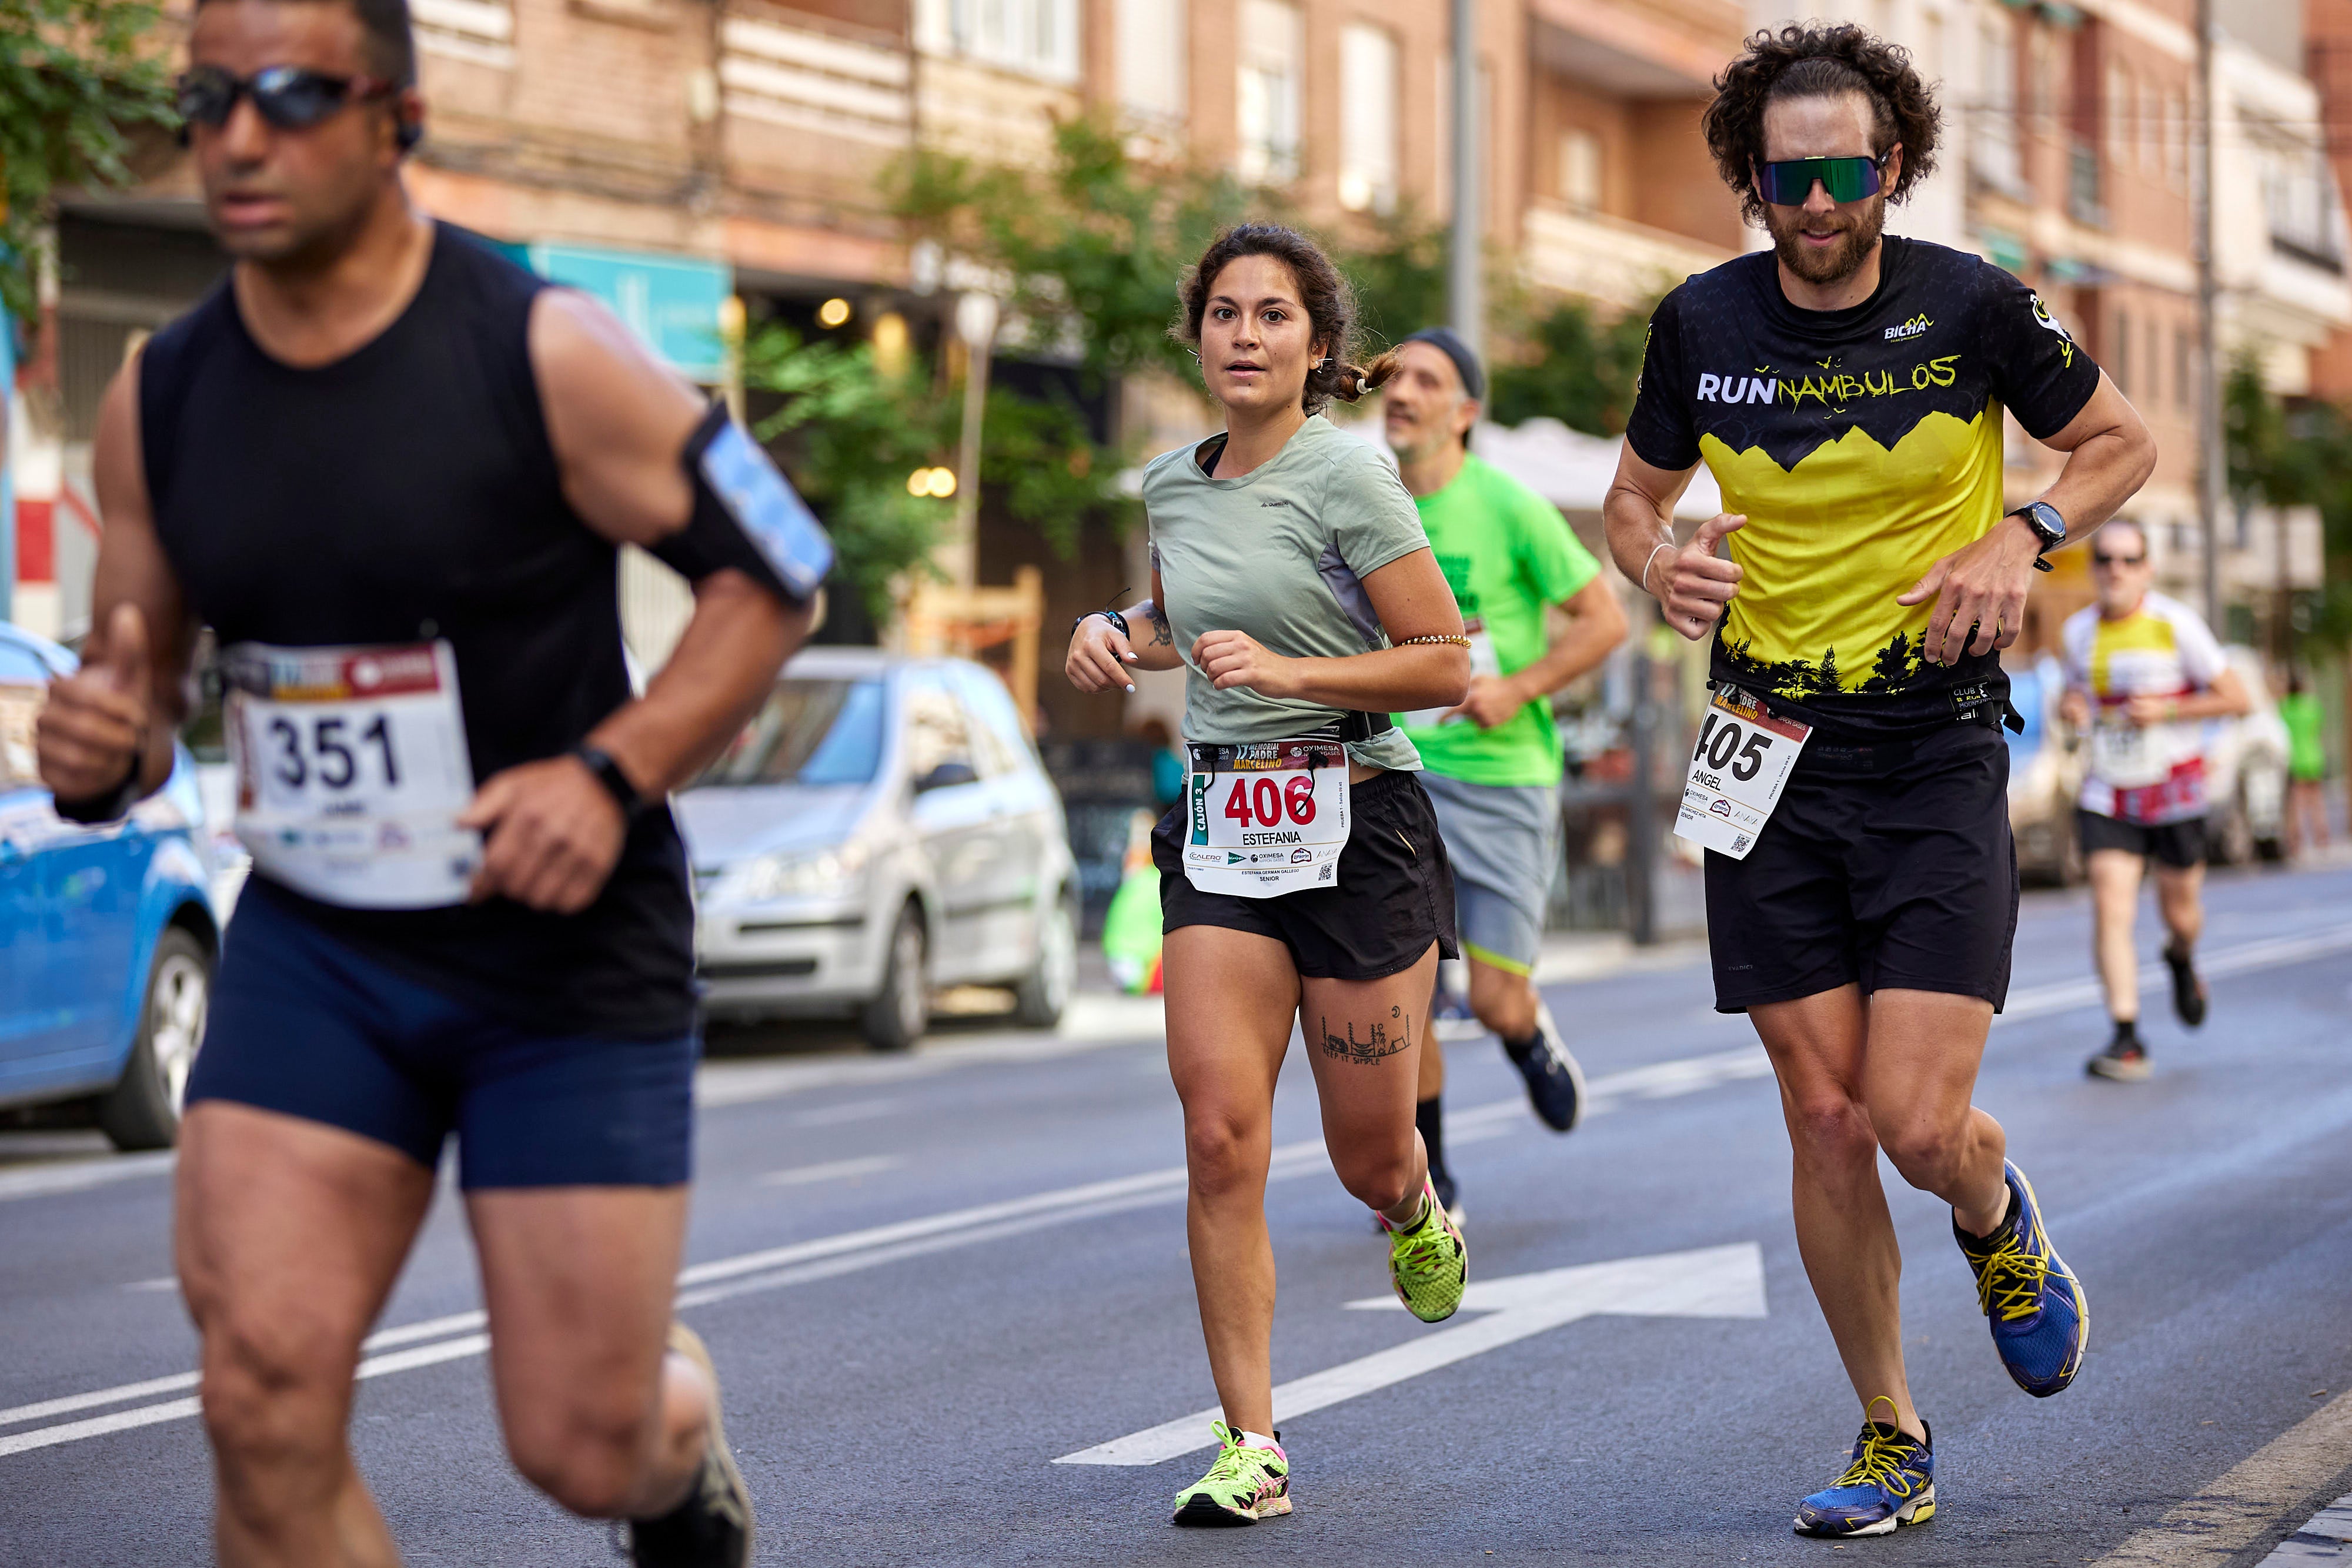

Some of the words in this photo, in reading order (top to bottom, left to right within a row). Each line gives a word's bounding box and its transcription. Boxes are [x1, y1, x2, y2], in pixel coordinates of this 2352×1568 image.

[1885, 321, 1926, 339] BICHA
[1954, 687, 1975, 696] CLUB
[269, 713, 398, 789] 351
[1236, 743, 1249, 759] 17
[1250, 750, 1278, 759] PADRE
[1234, 758, 1282, 769] MARCELINO
[1692, 770, 1721, 791] ANGEL
[1225, 775, 1316, 828] 406
[1690, 790, 1708, 801] OXIMESA
[1194, 798, 1205, 831] CAJÓN
[1681, 811, 1693, 821] SENIOR
[1734, 811, 1758, 826] ANAYA
[1242, 831, 1302, 845] ESTEFANIA
[1354, 1057, 1380, 1065] SIMPLE
